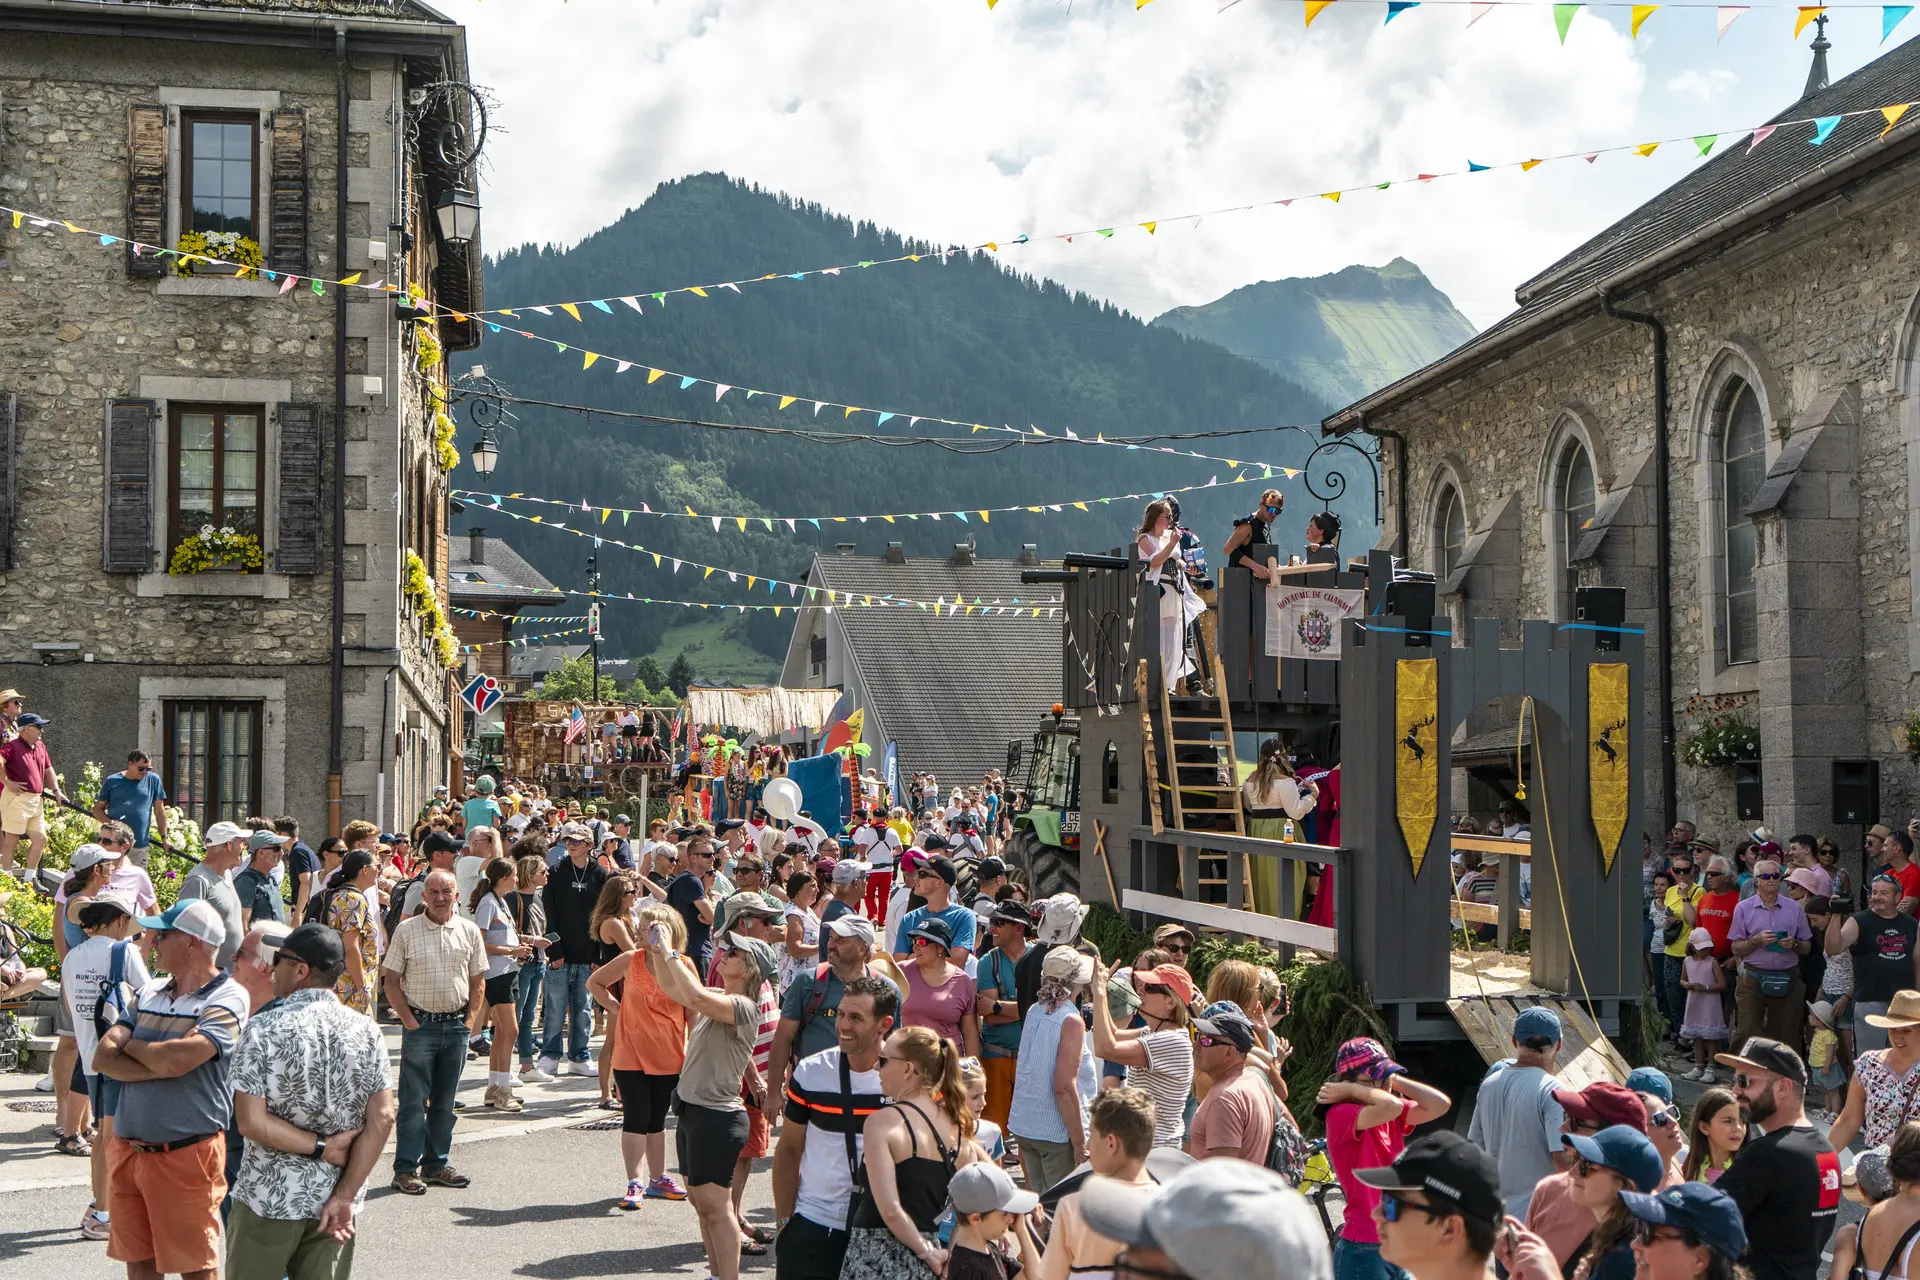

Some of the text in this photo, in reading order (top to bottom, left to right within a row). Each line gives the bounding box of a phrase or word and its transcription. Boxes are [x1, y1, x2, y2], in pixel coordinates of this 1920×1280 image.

[1277, 590, 1310, 609] ROYAUME
[1312, 590, 1321, 599] DE
[1069, 812, 1080, 822] CE
[92, 974, 107, 982] LYON
